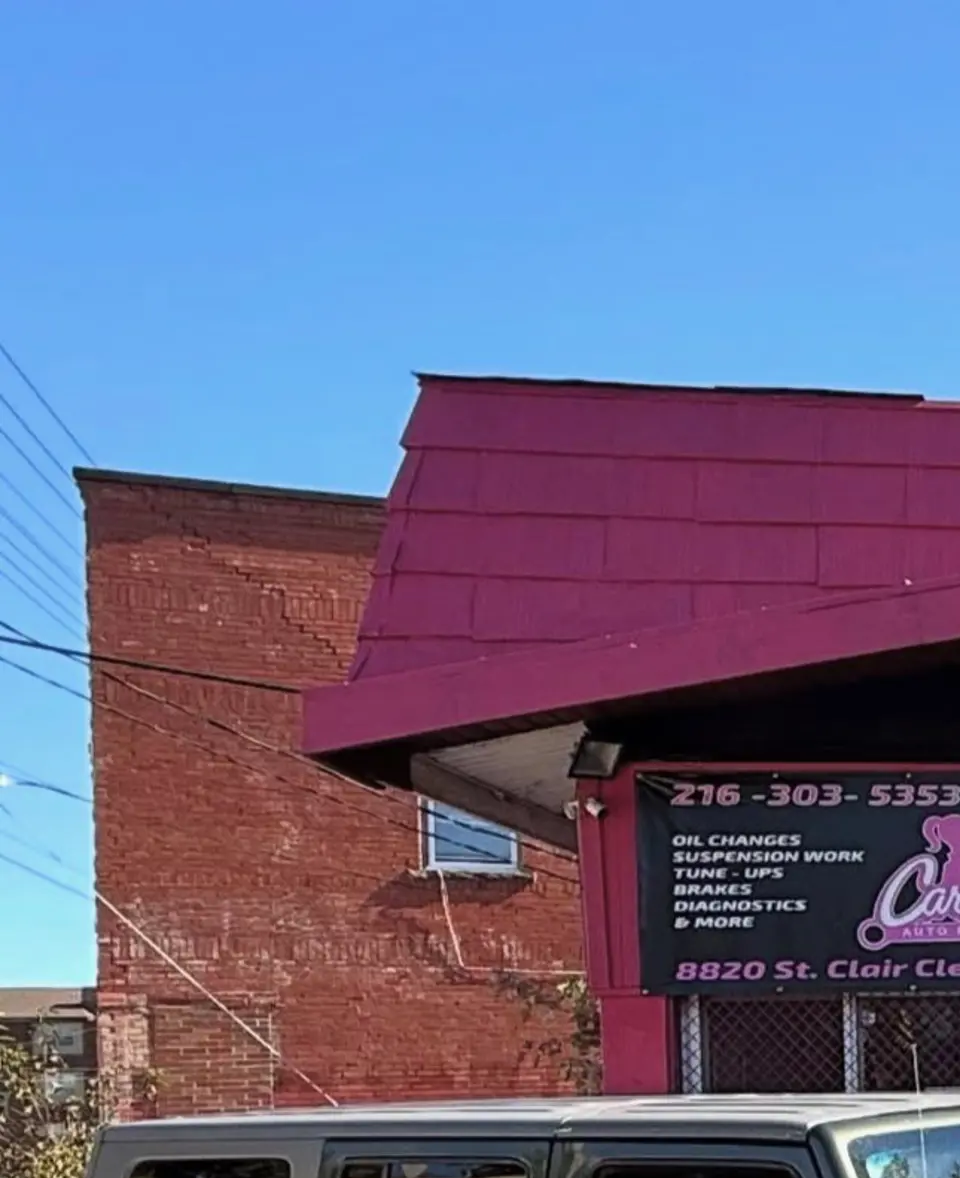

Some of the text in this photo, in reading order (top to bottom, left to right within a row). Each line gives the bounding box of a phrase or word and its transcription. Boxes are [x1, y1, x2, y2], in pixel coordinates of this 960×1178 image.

[671, 784, 741, 806] 216
[672, 834, 801, 847] OIL CHANGES
[672, 851, 864, 864] SUSPENSION WORK
[674, 867, 728, 879] TUNE
[744, 867, 784, 879] UPS
[674, 884, 752, 896] BRAKES
[674, 900, 807, 912] DIAGNOSTICS
[674, 916, 755, 929] & MORE
[902, 925, 948, 938] AUTO
[676, 961, 766, 981] 8820
[773, 961, 818, 980] St.
[827, 959, 907, 979] Clair
